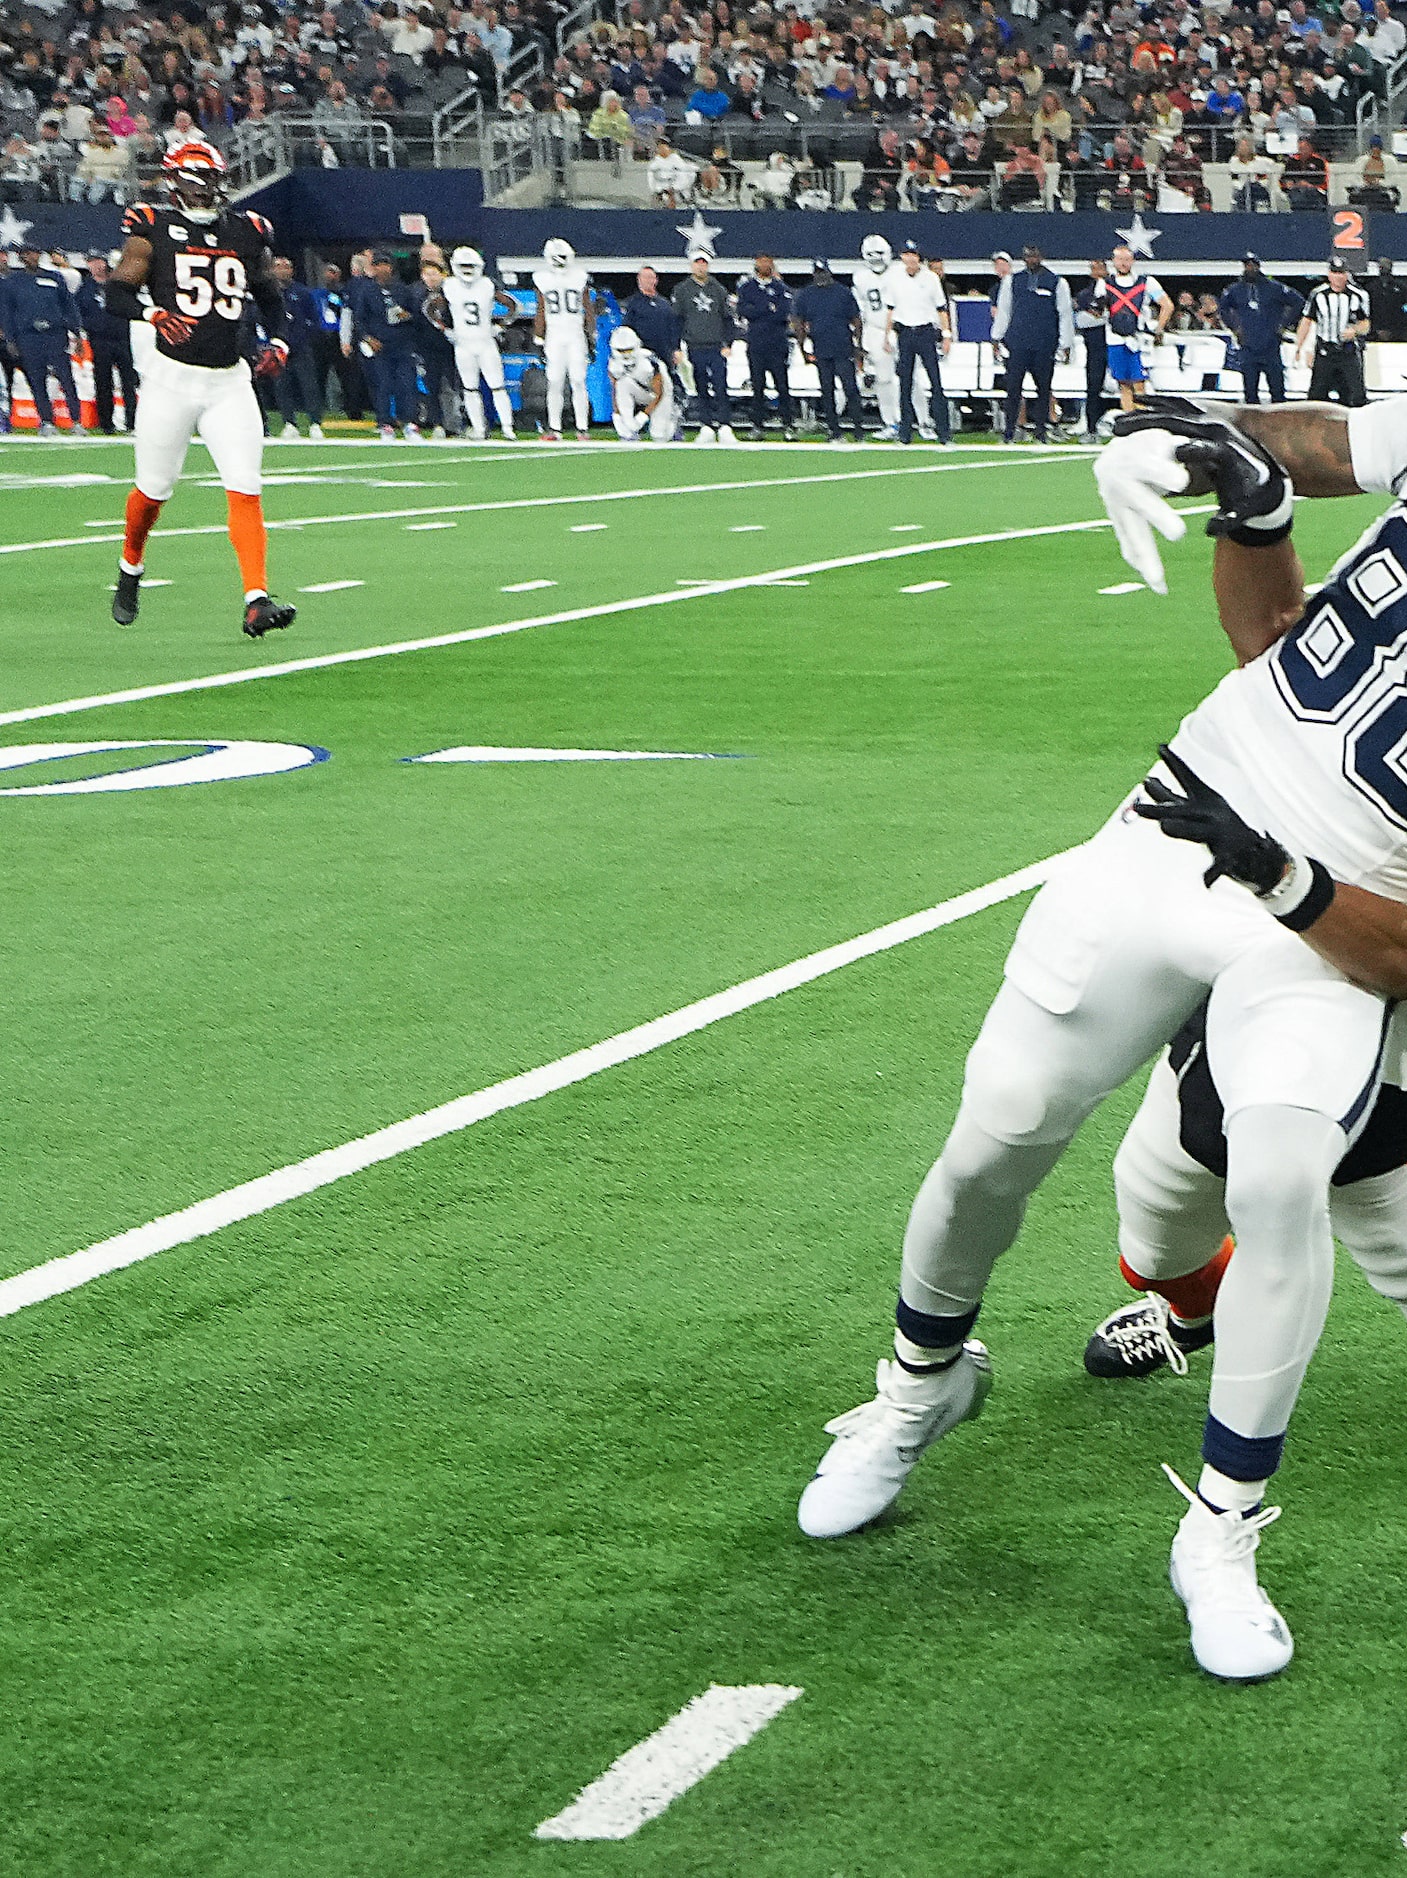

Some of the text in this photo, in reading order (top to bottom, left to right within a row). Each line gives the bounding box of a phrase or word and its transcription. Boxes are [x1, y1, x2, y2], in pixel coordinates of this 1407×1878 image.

[1333, 210, 1365, 249] 2
[174, 253, 247, 320] 59
[462, 301, 480, 326] 3
